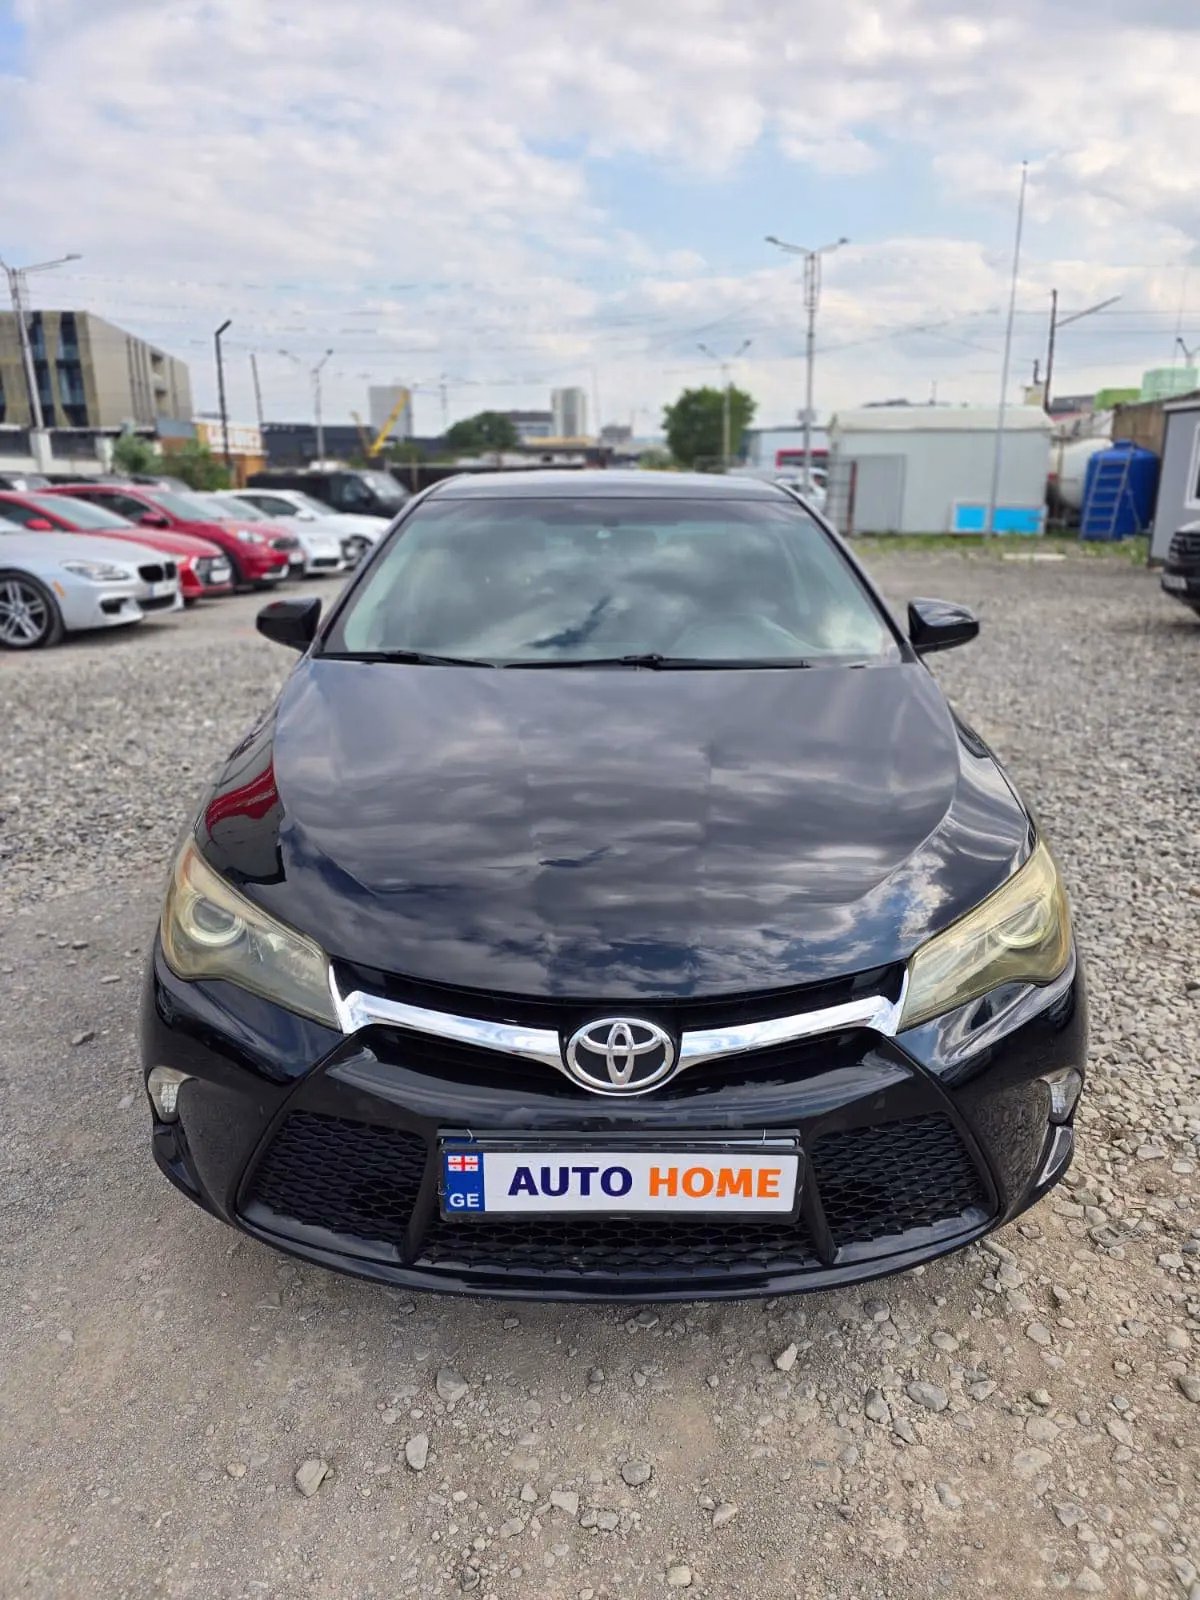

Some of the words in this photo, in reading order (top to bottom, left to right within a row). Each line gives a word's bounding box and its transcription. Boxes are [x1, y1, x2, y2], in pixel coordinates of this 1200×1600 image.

[507, 1166, 633, 1198] AUTO
[649, 1166, 782, 1198] HOME
[449, 1193, 480, 1208] GE
